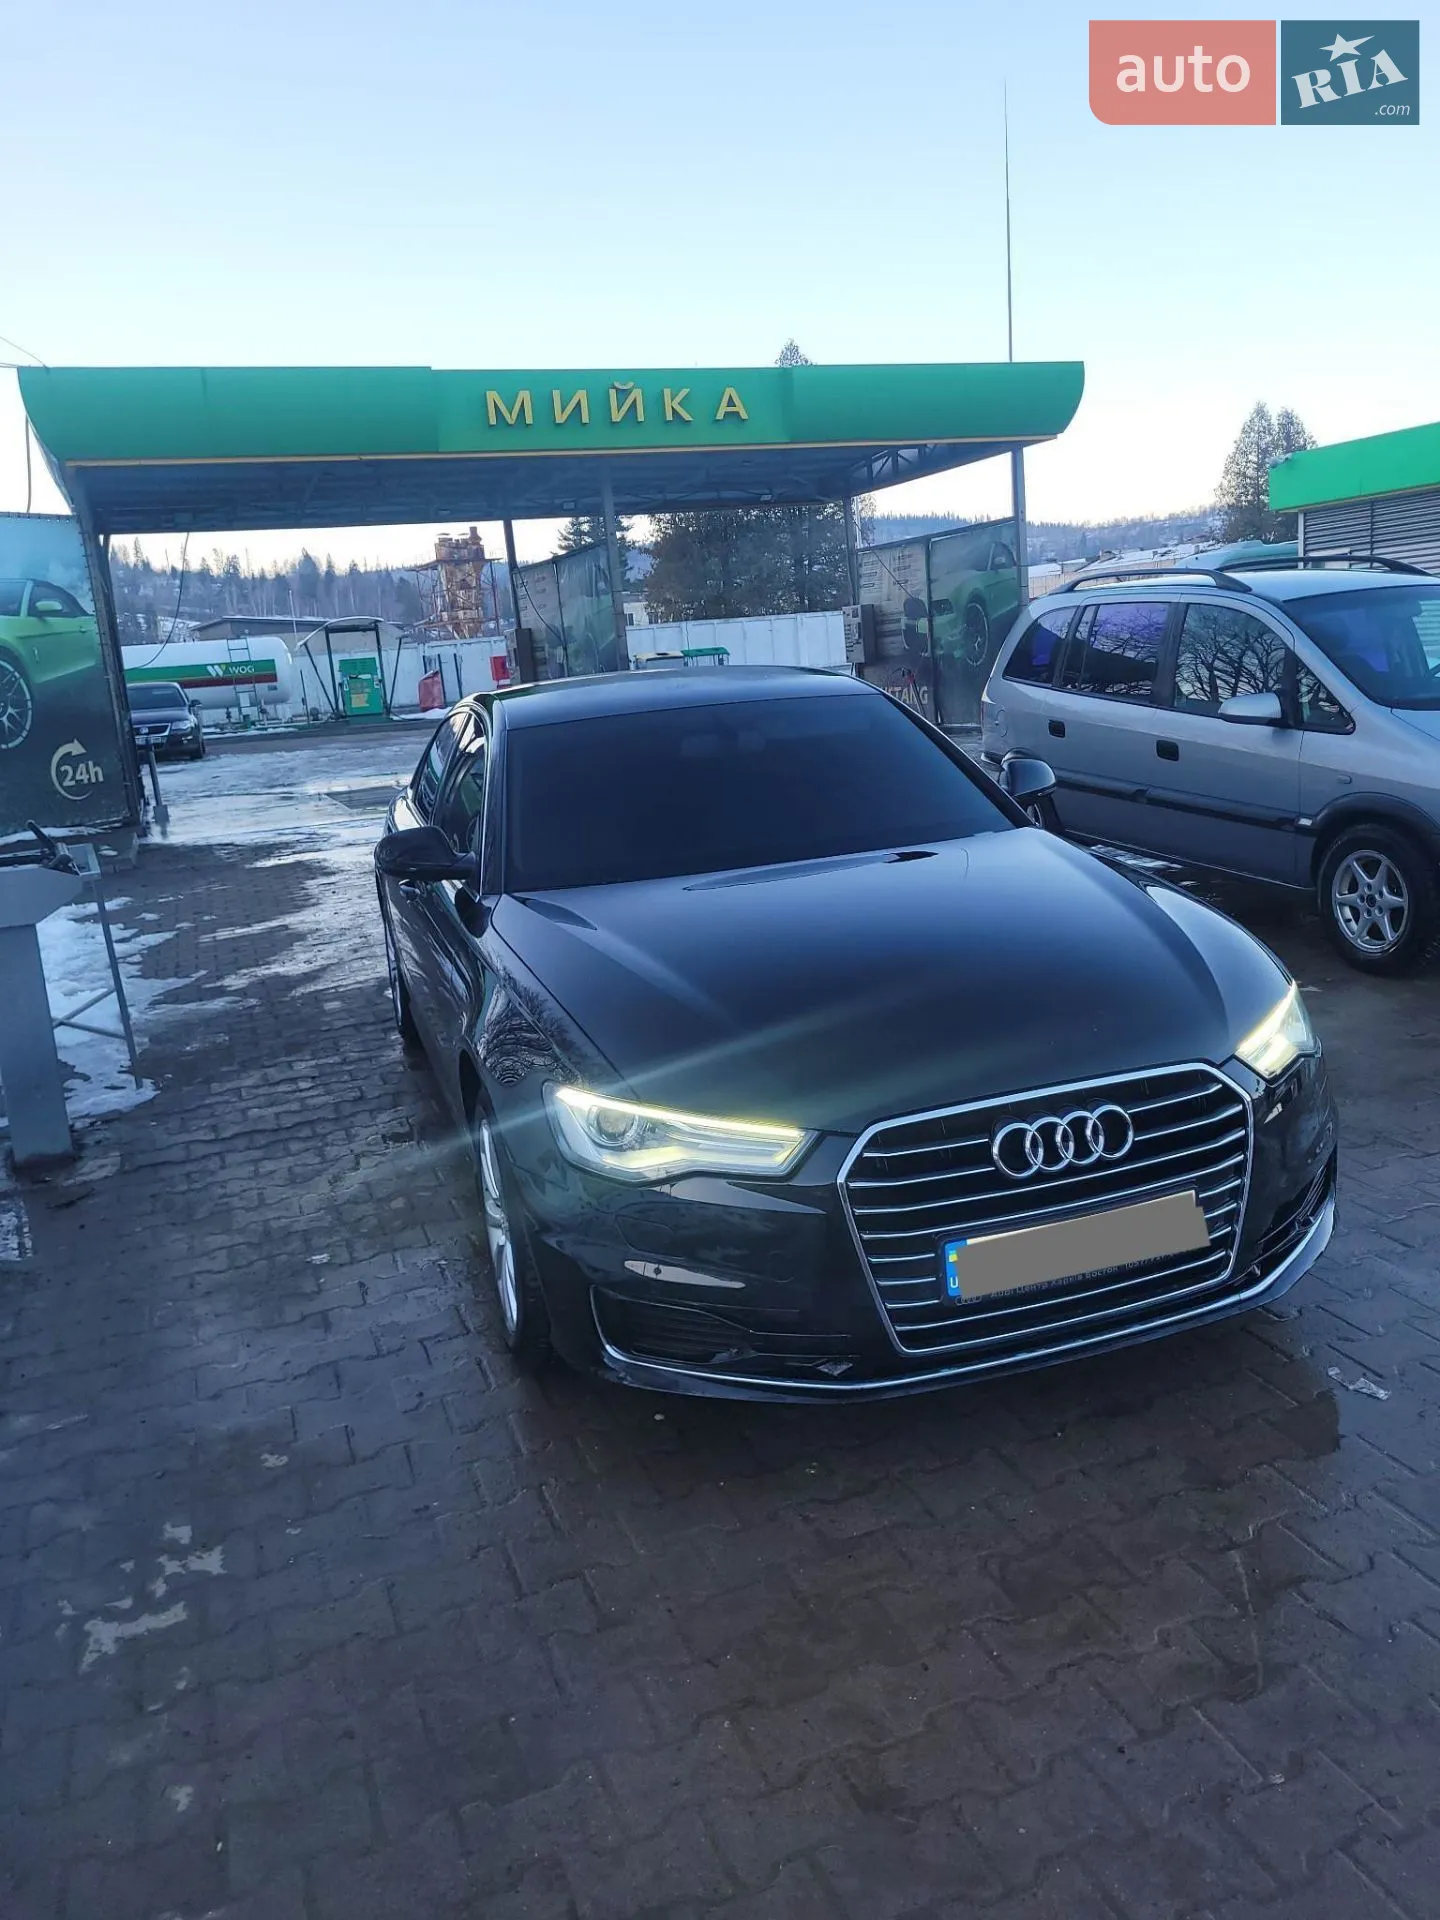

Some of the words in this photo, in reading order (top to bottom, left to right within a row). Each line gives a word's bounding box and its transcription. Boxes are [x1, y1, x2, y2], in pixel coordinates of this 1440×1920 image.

[485, 381, 749, 426] МИЙКА
[228, 664, 255, 675] WOG
[60, 760, 104, 787] 24h
